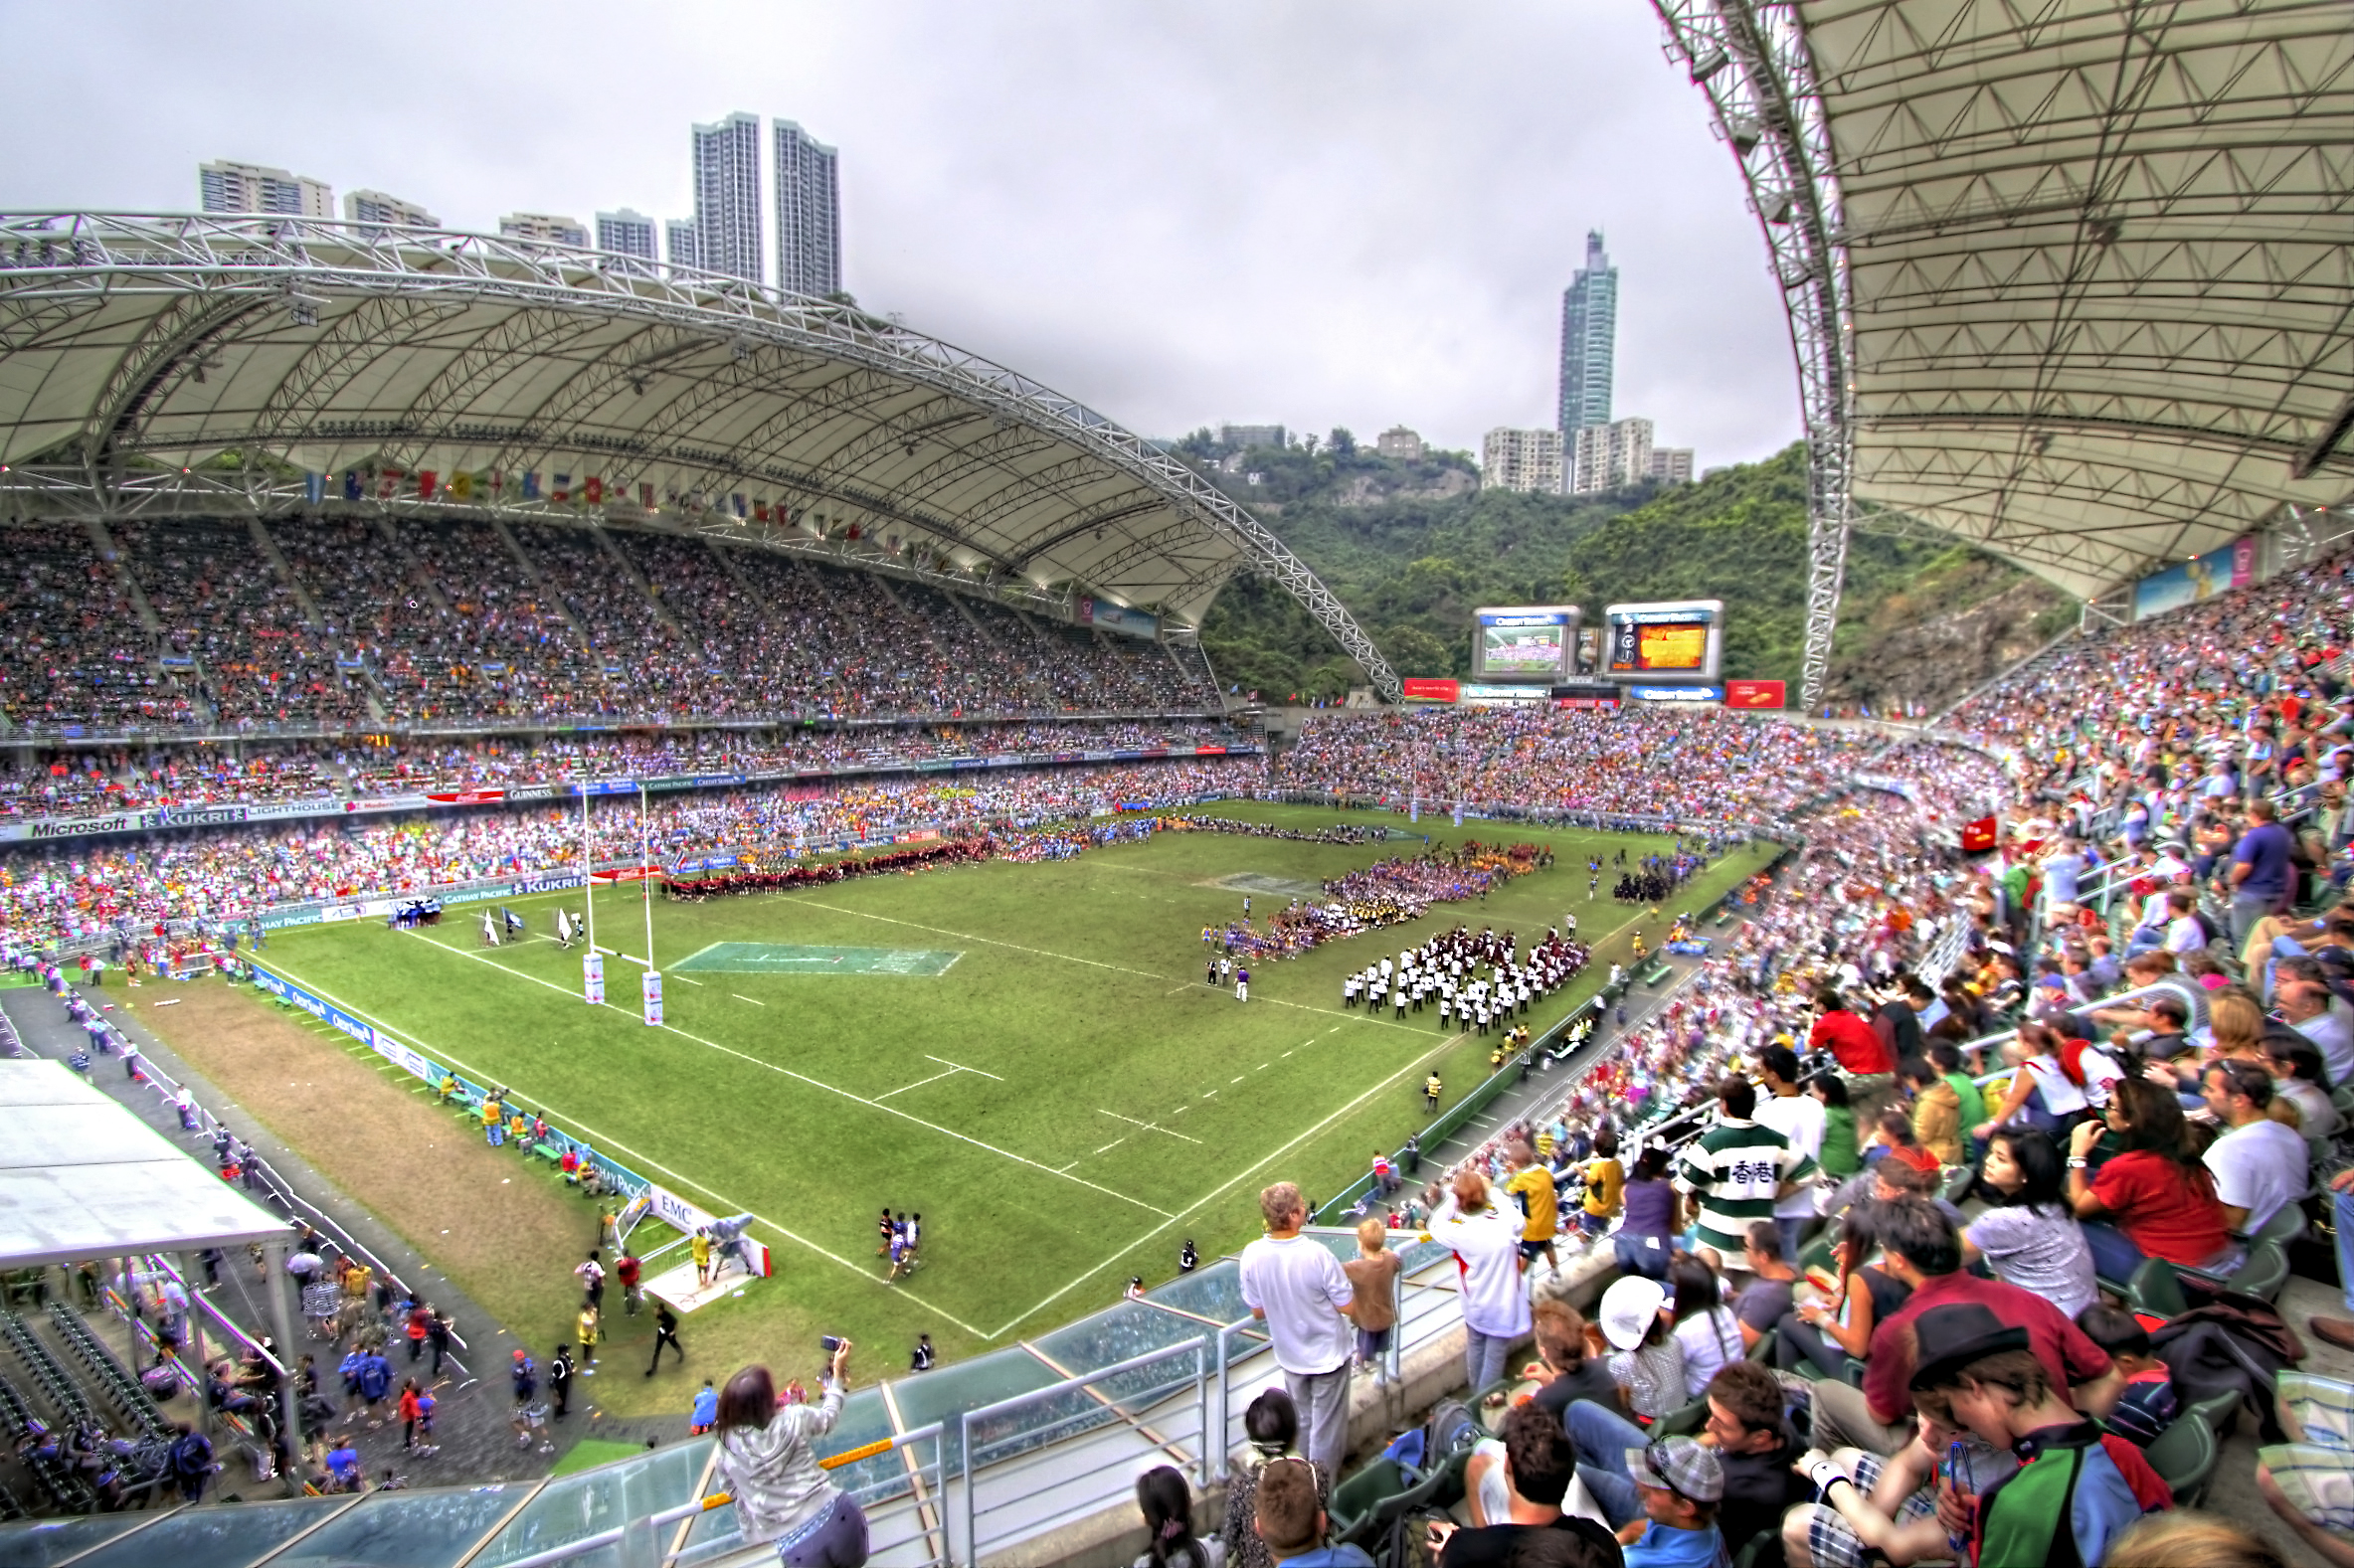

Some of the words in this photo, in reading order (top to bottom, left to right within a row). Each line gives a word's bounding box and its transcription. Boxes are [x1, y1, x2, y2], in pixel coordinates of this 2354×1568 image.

[510, 788, 553, 799] GUINNESS
[249, 800, 341, 815] LIGHTHOUSE
[161, 810, 229, 826] KUKRI
[32, 818, 128, 838] Microsoft
[527, 876, 578, 893] KUKRI
[445, 892, 479, 904] CATHAY
[480, 888, 512, 899] PACIFIC
[283, 915, 322, 926] PACIFIC
[1731, 1160, 1772, 1184] 香港
